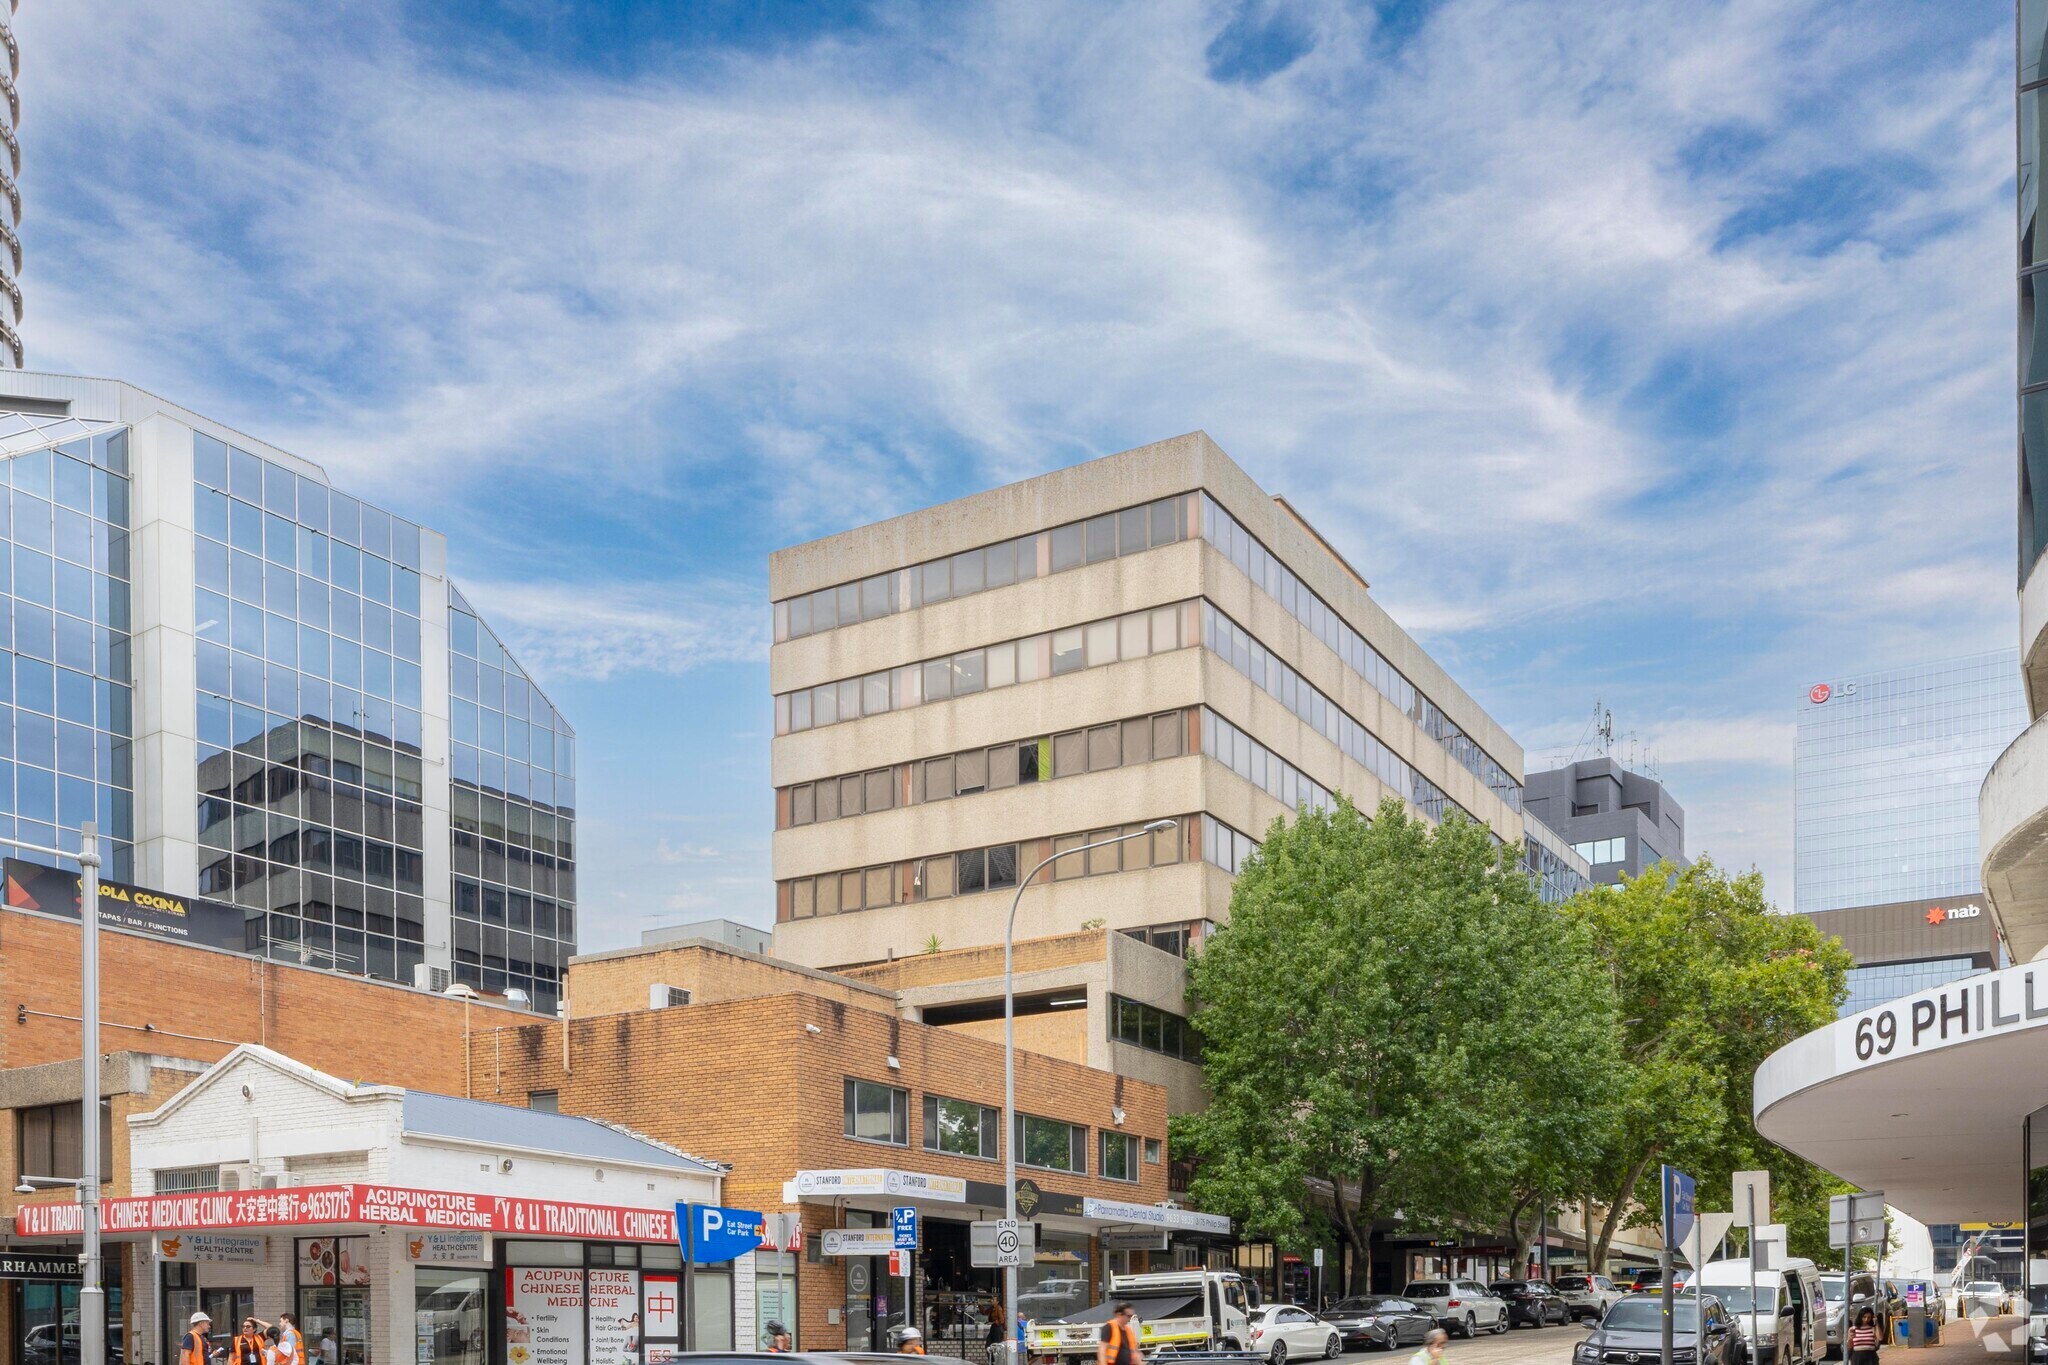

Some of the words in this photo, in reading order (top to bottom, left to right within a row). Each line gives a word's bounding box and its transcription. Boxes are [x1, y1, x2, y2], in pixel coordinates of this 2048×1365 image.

[1833, 680, 1857, 698] LG
[134, 892, 186, 914] COCINA
[1948, 904, 1980, 920] nab
[98, 911, 122, 922] TAPAS
[127, 917, 143, 927] BAR
[148, 922, 188, 936] FUNCTIONS
[1855, 1010, 1897, 1061] 69
[1912, 971, 2048, 1047] PHILL
[816, 1175, 842, 1185] STANFORD
[903, 1175, 927, 1188] STANFORD
[308, 1191, 351, 1220] 96351715
[366, 1188, 476, 1212] ACUPUNCTURE
[24, 1207, 31, 1233] Y
[32, 1206, 39, 1233] &
[41, 1206, 49, 1232] LI
[110, 1200, 149, 1229] CHINESE
[152, 1198, 198, 1228] MEDICINE
[200, 1195, 233, 1225] CLINIC
[359, 1204, 418, 1223] HERBAL
[425, 1208, 492, 1228] MEDICINE
[502, 1201, 511, 1229] Y
[515, 1202, 525, 1230] &
[529, 1203, 540, 1231] LI
[543, 1204, 620, 1237] TRADITIONAL
[623, 1211, 668, 1240] CHINESE
[1129, 1208, 1147, 1220] Dental
[1148, 1210, 1165, 1222] Studio
[703, 1208, 723, 1242] P
[727, 1220, 736, 1228] Eat
[737, 1221, 753, 1230] Street
[998, 1220, 1017, 1229] END
[427, 1235, 433, 1243] Y
[433, 1235, 439, 1243] &
[447, 1234, 483, 1244] Integrative
[727, 1228, 736, 1236] Car
[737, 1229, 749, 1237] Park
[842, 1233, 865, 1242] STANFORD
[187, 1235, 193, 1243] Y
[195, 1236, 202, 1244] &
[214, 1236, 260, 1247] Integrative
[455, 1243, 478, 1251] CENTRE
[1000, 1235, 1016, 1248] 40
[193, 1245, 224, 1253] HEALTH
[224, 1246, 254, 1255] CENTRE
[998, 1255, 1018, 1263] AREA
[0, 1260, 86, 1275] RHAMMER
[520, 1284, 580, 1294] CHINESE
[590, 1285, 635, 1296] HERBAL
[648, 1291, 674, 1323] 中
[536, 1314, 559, 1323] Fertility
[595, 1315, 616, 1323] Healthy
[536, 1326, 550, 1334] Skin
[536, 1357, 568, 1365] Wellbeing
